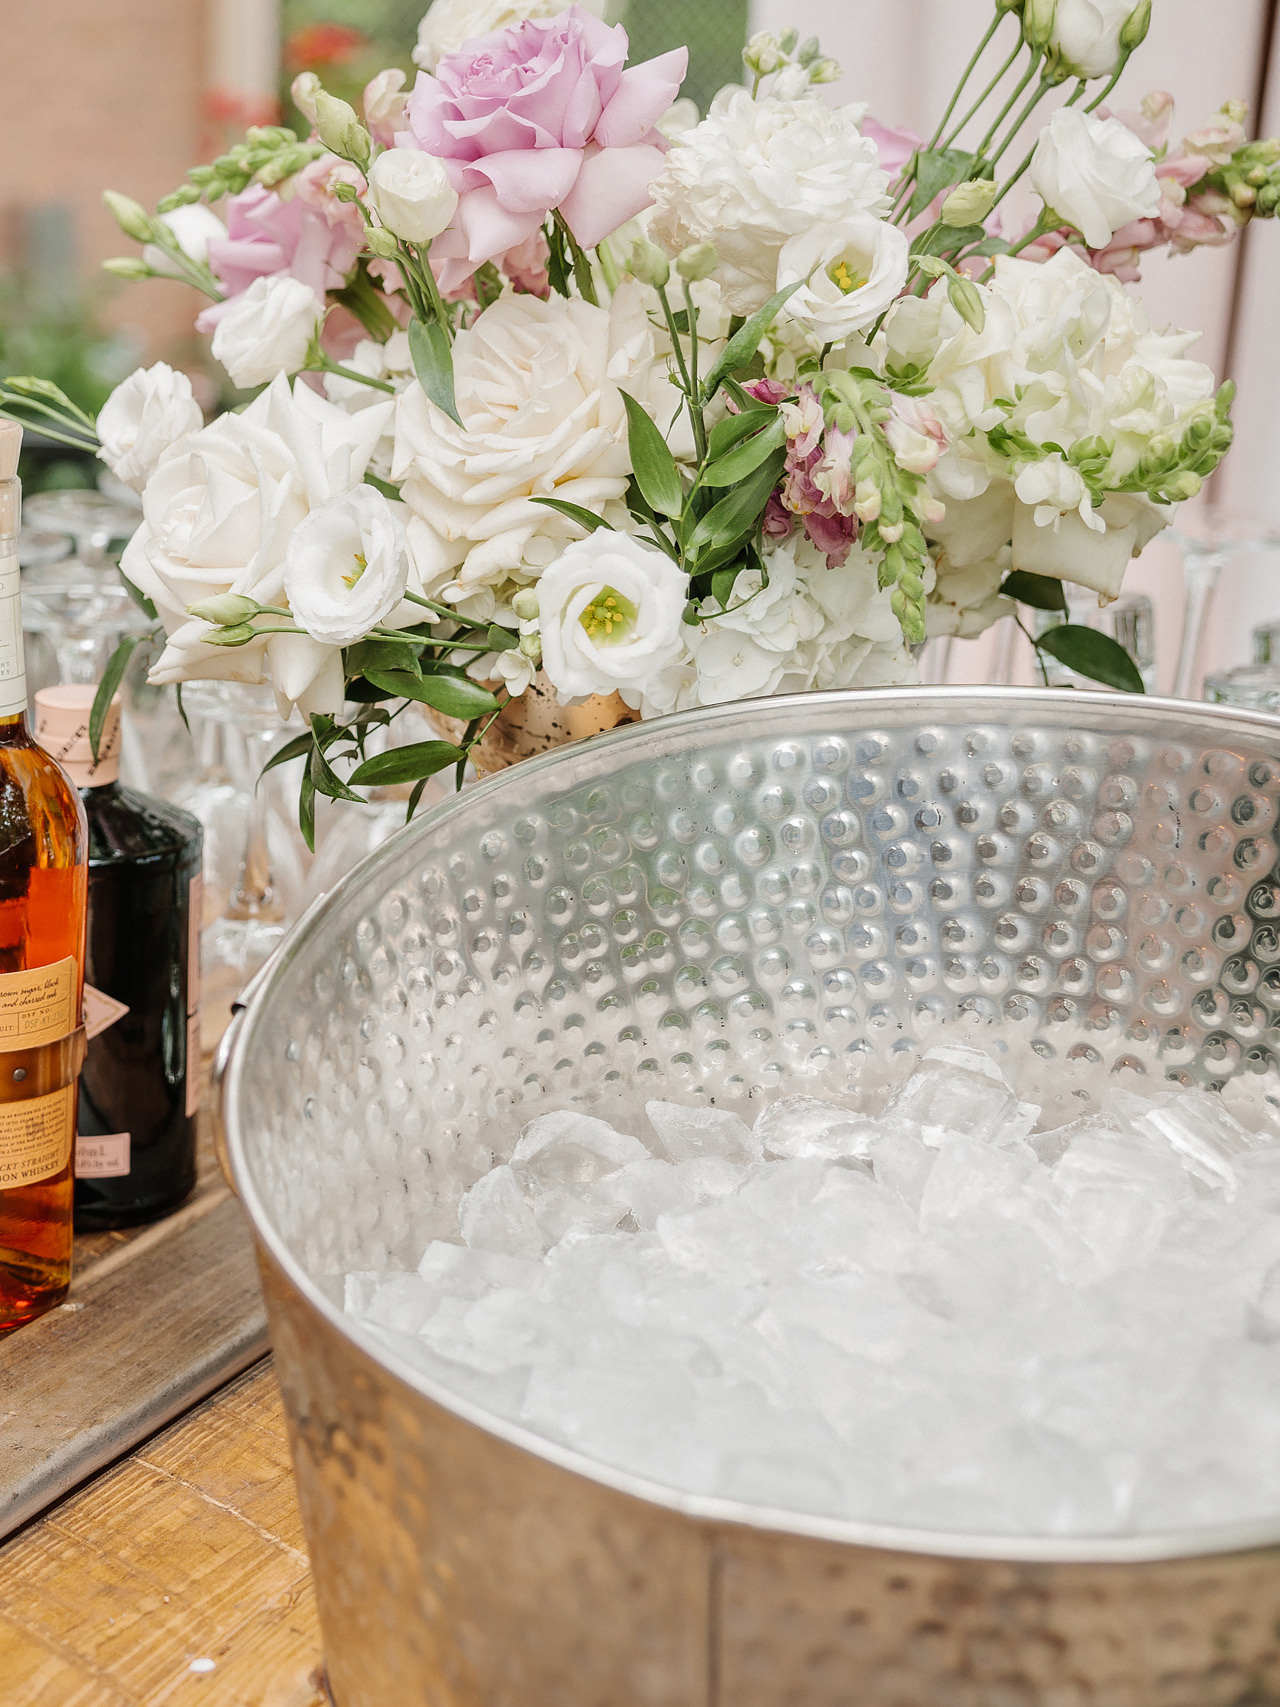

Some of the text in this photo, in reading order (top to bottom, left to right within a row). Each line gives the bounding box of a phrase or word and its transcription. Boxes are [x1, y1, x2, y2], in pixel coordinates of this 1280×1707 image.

[2, 999, 18, 1008] and
[20, 1149, 60, 1167] STRAIGHT
[21, 1160, 60, 1178] WHISKEY
